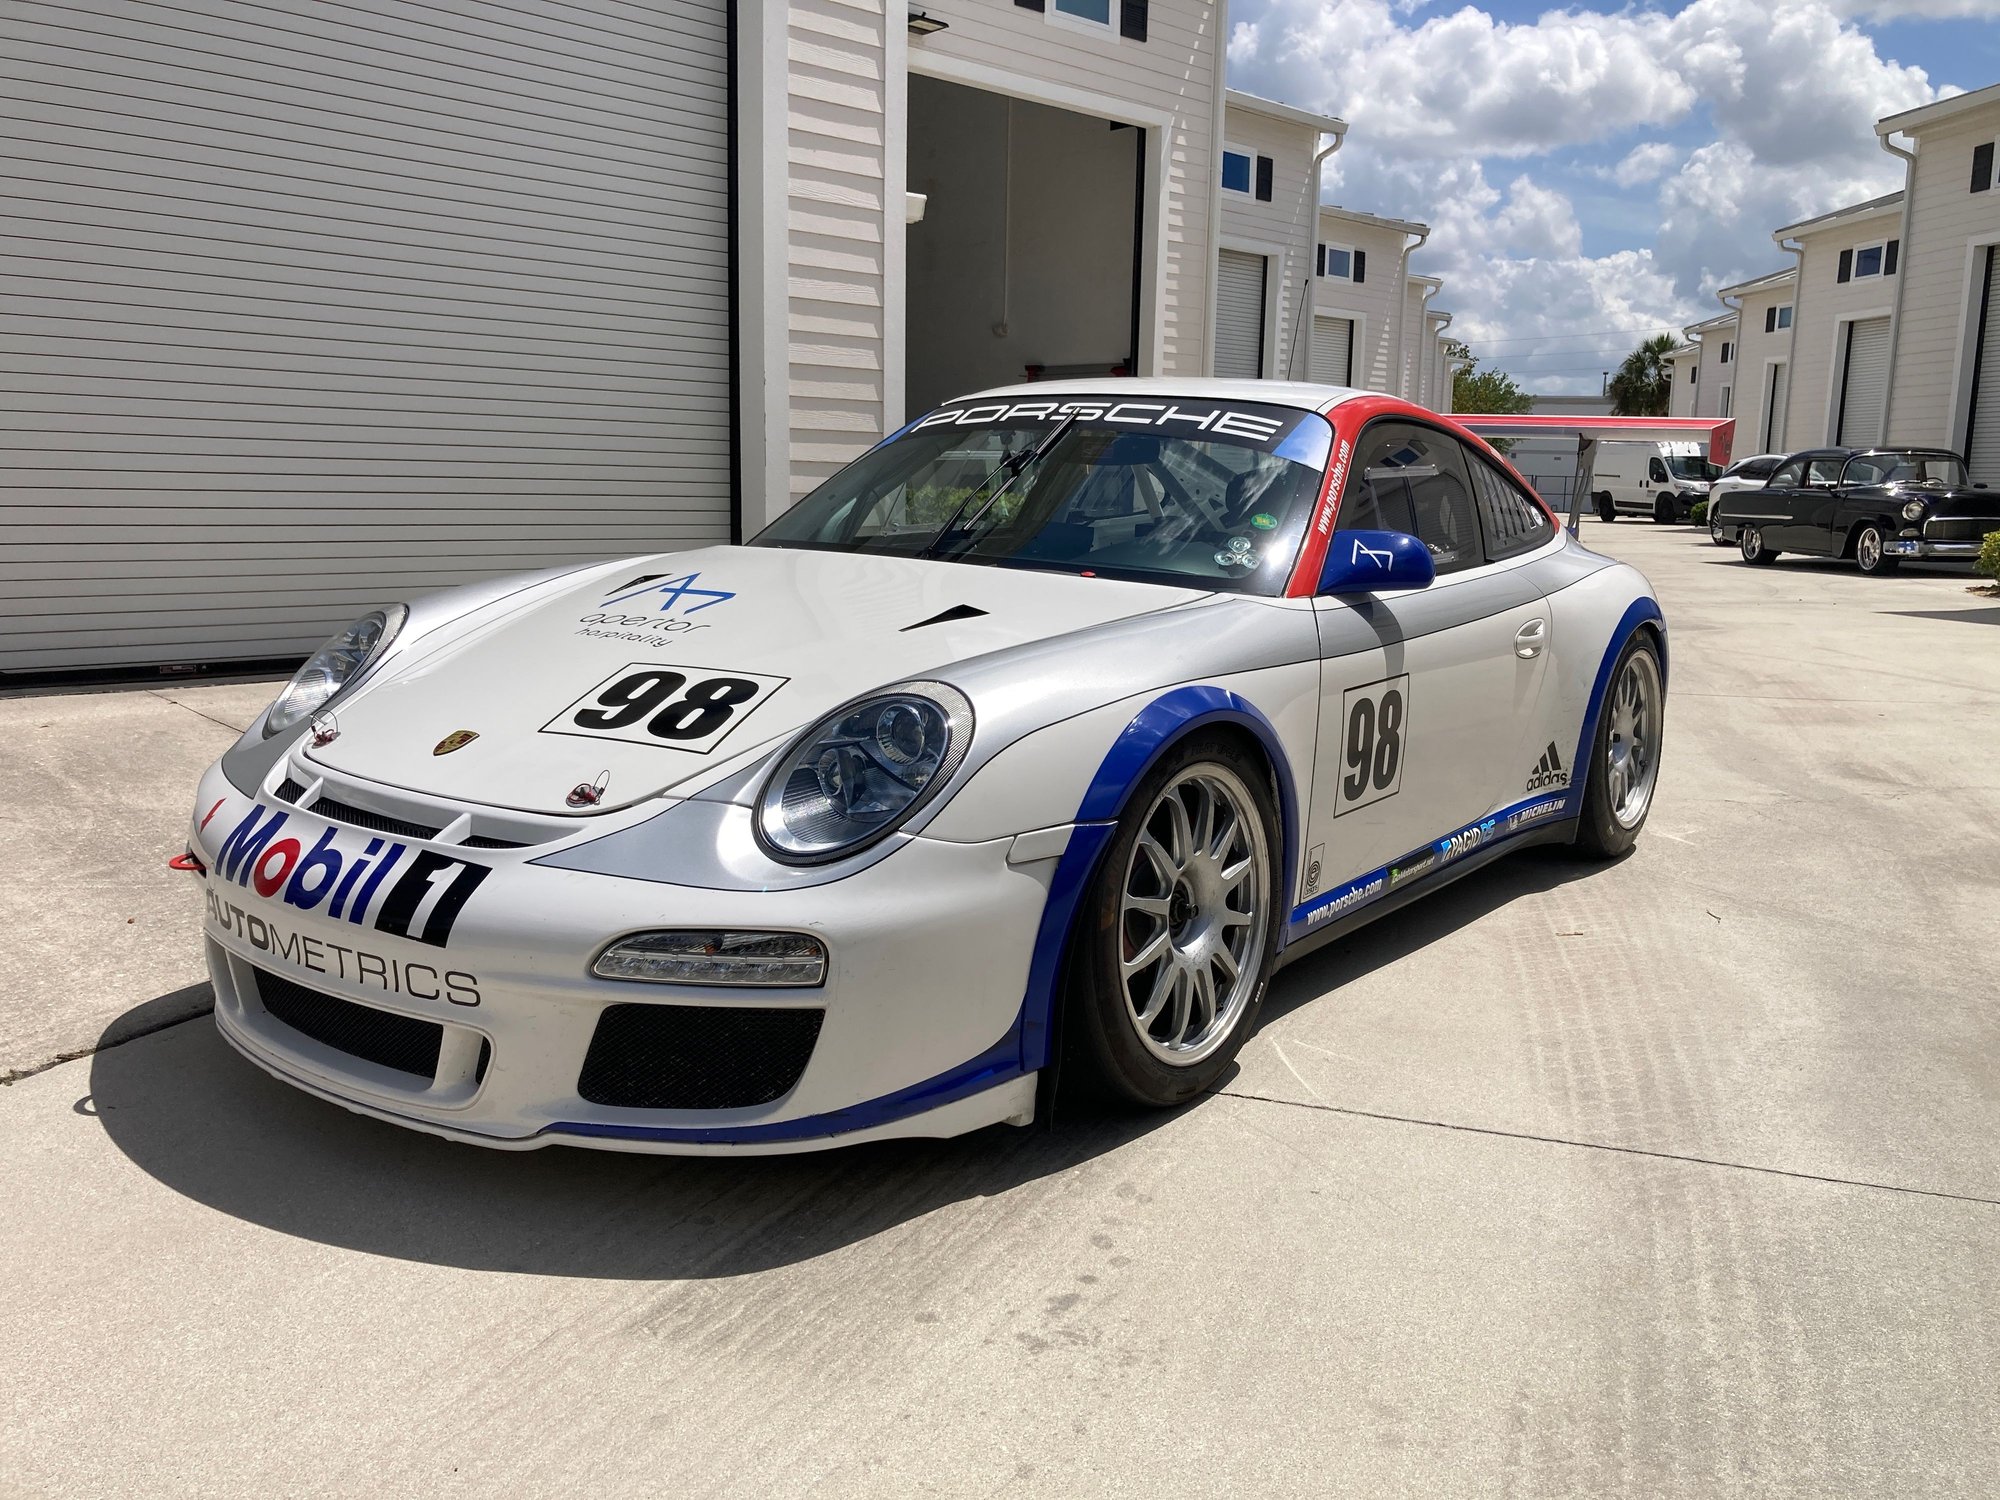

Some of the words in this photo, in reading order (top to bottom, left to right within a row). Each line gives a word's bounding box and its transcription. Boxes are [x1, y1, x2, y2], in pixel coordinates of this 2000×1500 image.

[910, 402, 1284, 442] PORSCHE
[1317, 439, 1351, 536] www.porsche.com
[574, 627, 673, 647] hospitality
[579, 613, 711, 634] apertor
[573, 670, 760, 741] 98
[1343, 689, 1403, 802] 98
[1526, 771, 1568, 792] adidas
[1519, 798, 1567, 822] MICHELIN
[1450, 827, 1481, 858] PAGID
[215, 804, 407, 926] Mobil
[406, 862, 467, 939] 1
[1307, 878, 1384, 925] www.porsche.com
[205, 889, 482, 1008] AUTOMETRICS
